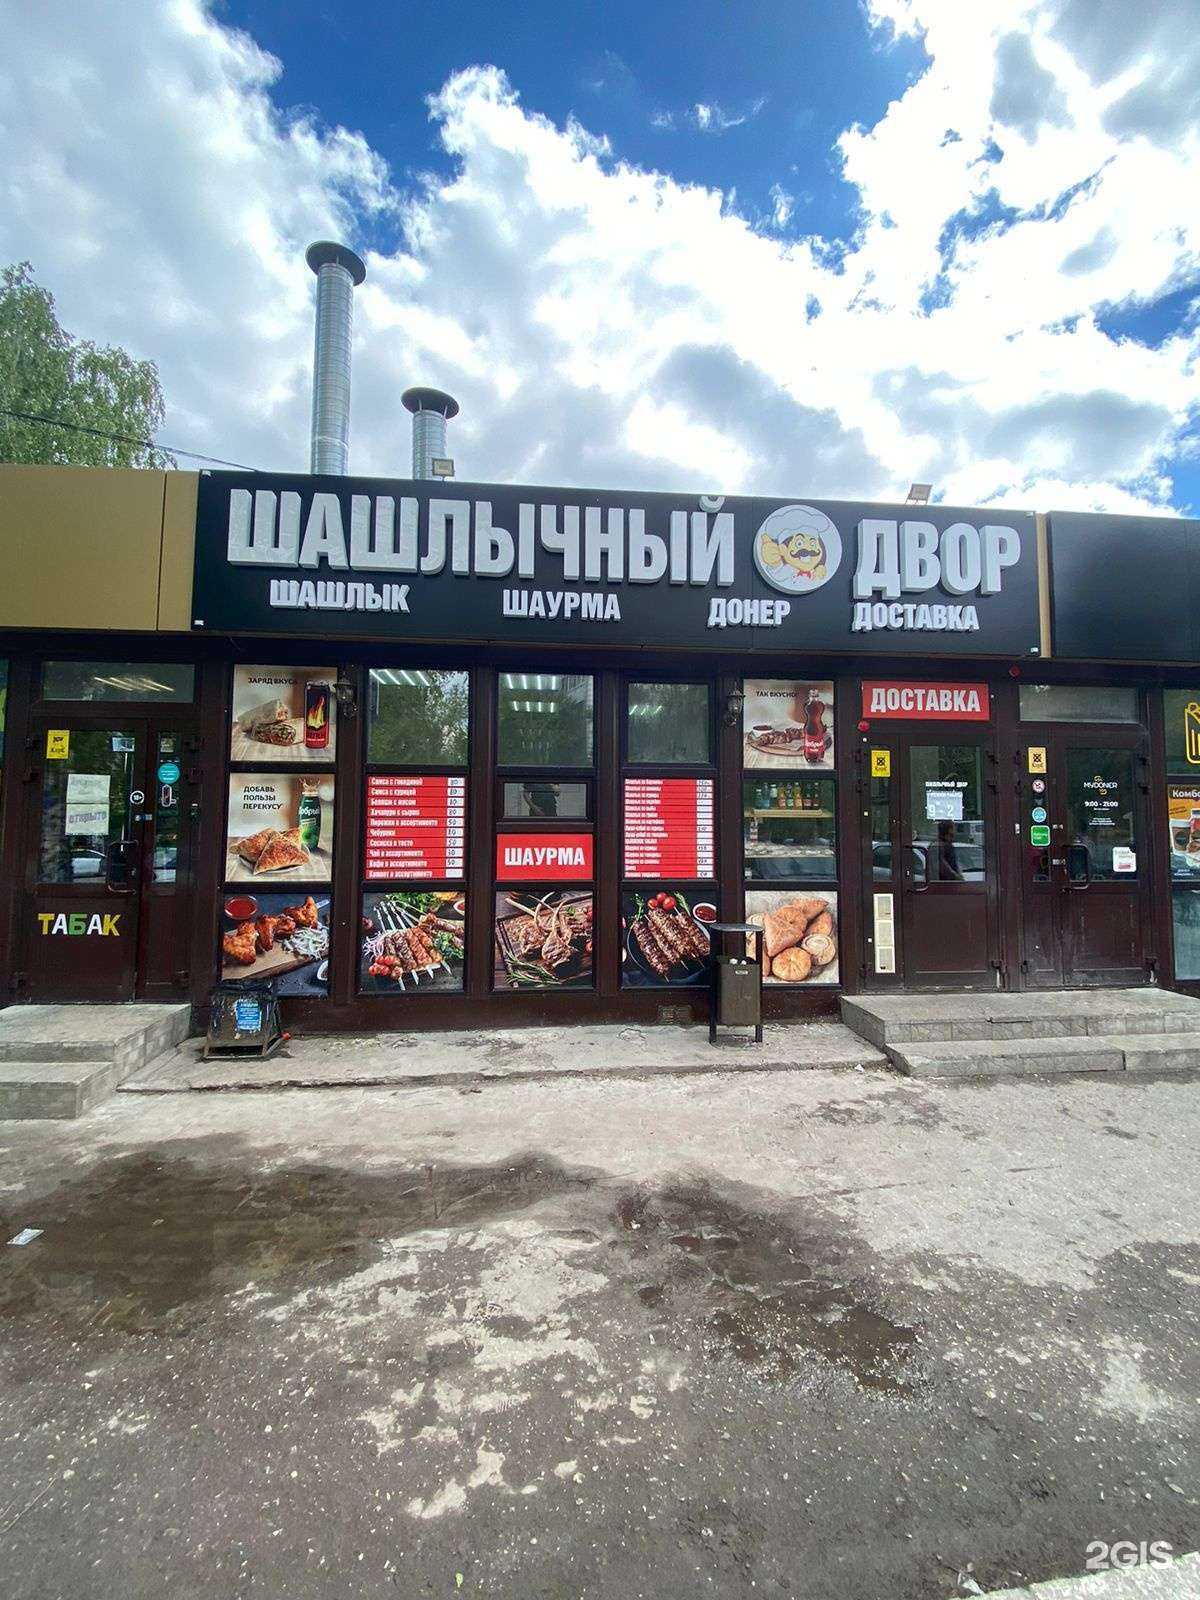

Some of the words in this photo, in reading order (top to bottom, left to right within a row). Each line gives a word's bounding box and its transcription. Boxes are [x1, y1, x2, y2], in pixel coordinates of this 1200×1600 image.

[227, 488, 735, 587] ШАШЛЫЧНЫЙ
[853, 518, 1021, 599] ДВОР
[270, 579, 411, 613] ШАШЛЫК
[502, 589, 622, 621] ШАУРМА
[708, 597, 791, 628] ДОНЕР
[852, 602, 980, 632] ДОСТАВКА
[248, 677, 273, 685] ЗАРЯД
[870, 687, 981, 713] ДОСТАВКА
[243, 785, 275, 793] ДОБАВЬ
[243, 794, 276, 802] ПОЛЬЗЫ
[504, 847, 586, 866] ШАУРМА
[38, 913, 121, 936] ТАБАК
